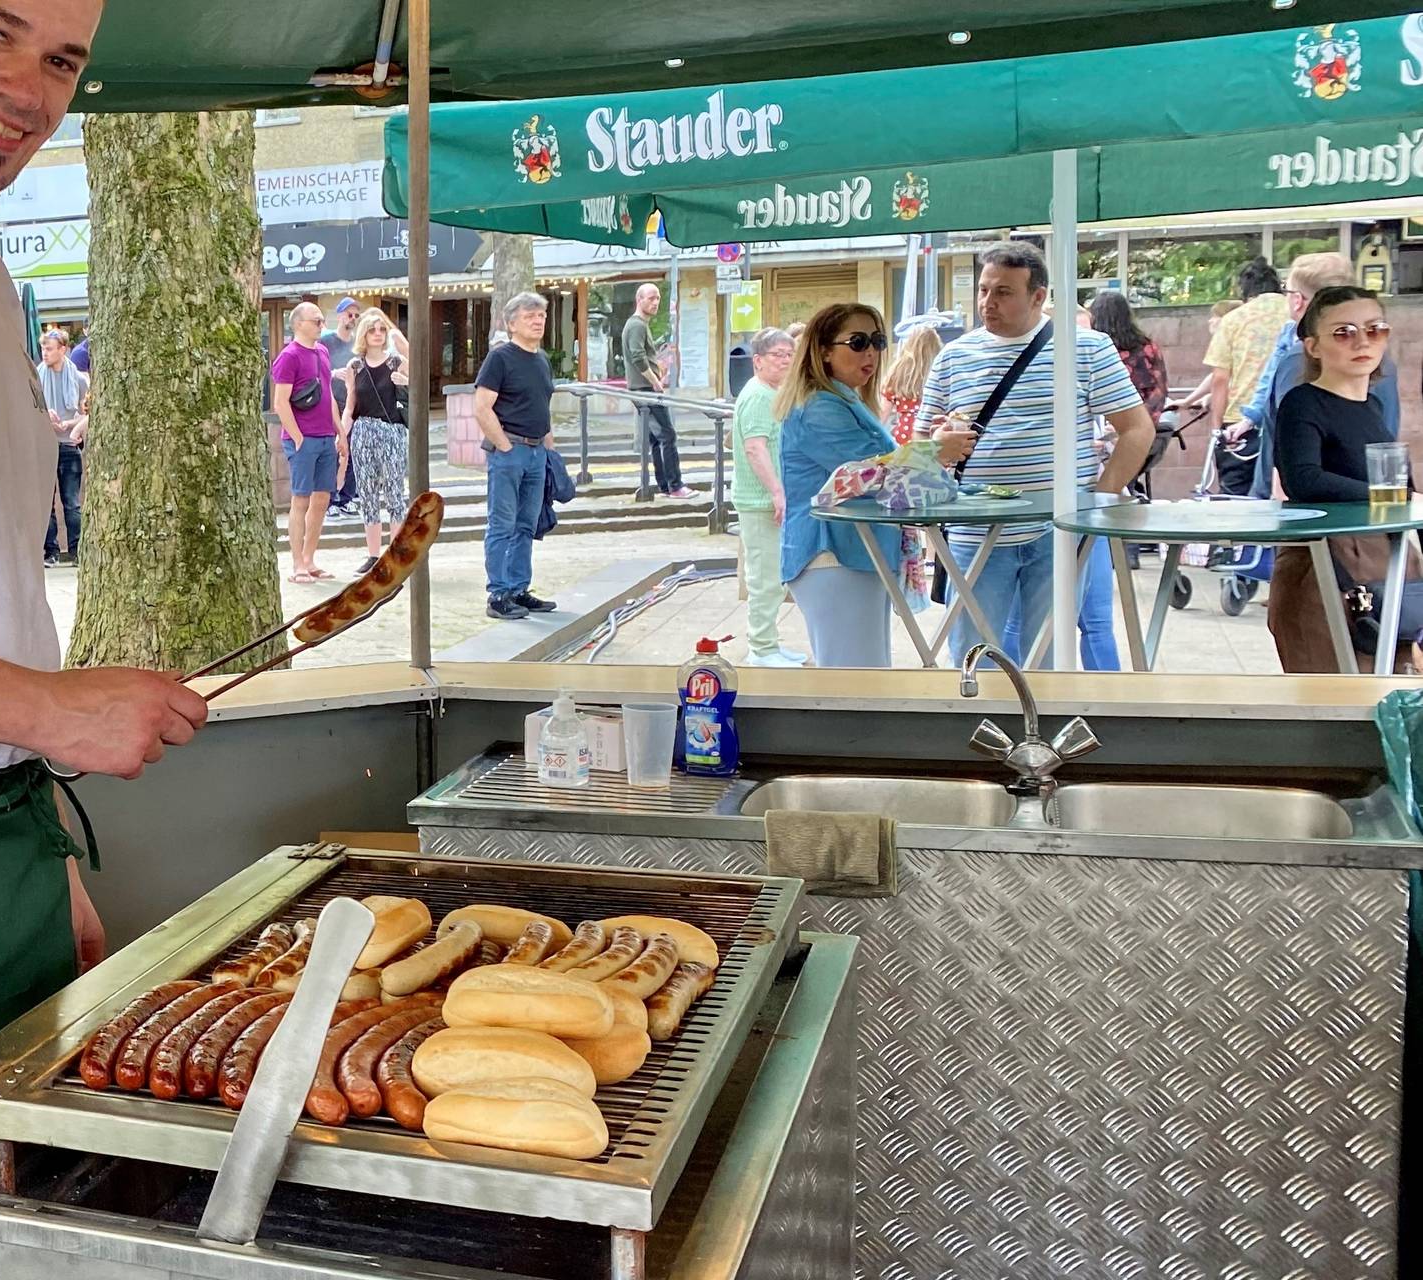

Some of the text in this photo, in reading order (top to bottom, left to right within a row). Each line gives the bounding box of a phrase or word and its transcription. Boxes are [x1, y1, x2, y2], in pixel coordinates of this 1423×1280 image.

[584, 88, 784, 177] Stauder
[258, 168, 381, 191] EMEINSCHAFTE
[263, 242, 326, 269] 809
[691, 678, 715, 697] Pril
